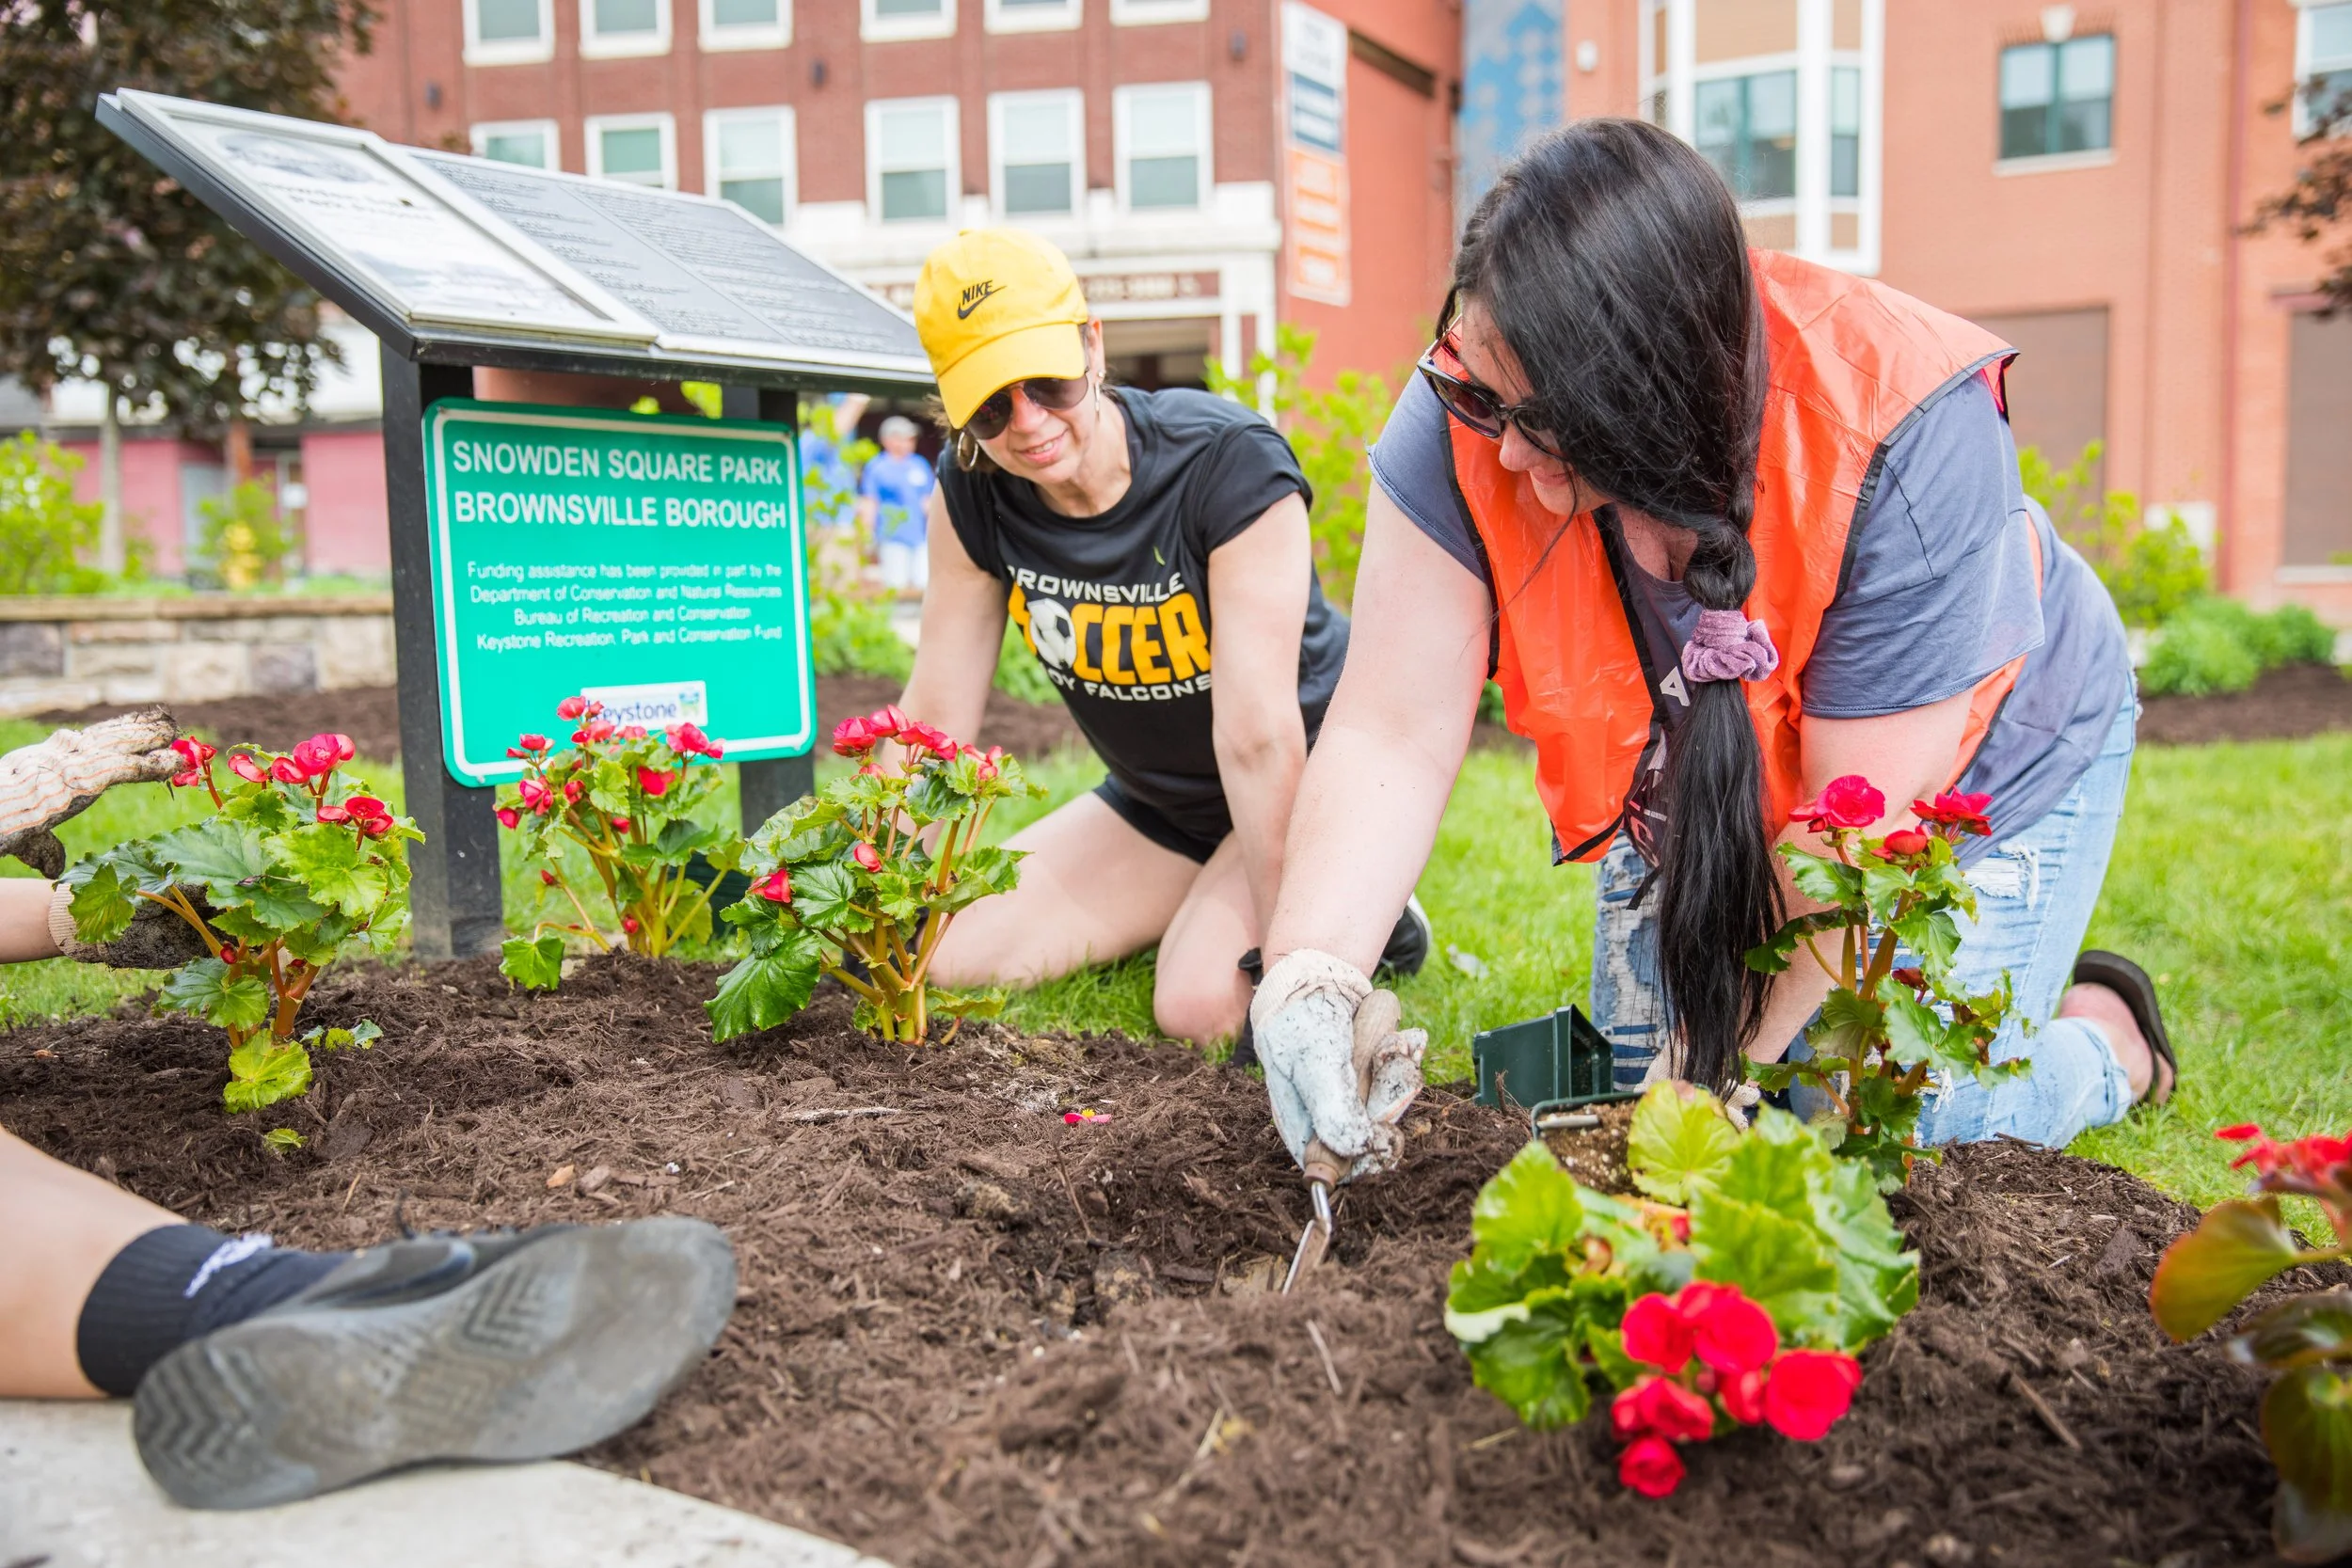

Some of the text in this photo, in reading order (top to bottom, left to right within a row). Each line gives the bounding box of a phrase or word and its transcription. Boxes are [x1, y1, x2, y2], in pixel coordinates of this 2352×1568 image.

[962, 279, 993, 307] NIKE
[453, 439, 783, 485] SNOWDEN SQUARE PARK
[454, 491, 787, 530] BROWNSVILLE BOROUGH
[468, 561, 524, 583] Funding
[528, 564, 597, 579] assistance
[599, 563, 623, 578] has
[626, 563, 657, 578] been
[660, 564, 709, 579] provided
[725, 564, 747, 579] part
[765, 563, 782, 577] the
[470, 582, 783, 606] Department of Conservation and Natural Resources
[514, 605, 752, 626] Bureau of Recreation and Conservation
[477, 633, 542, 654] Keystone
[621, 628, 649, 645] Park
[653, 629, 675, 644] and
[678, 626, 753, 643] Conservation
[754, 624, 783, 641] Fund
[1084, 673, 1212, 702] FALCONS
